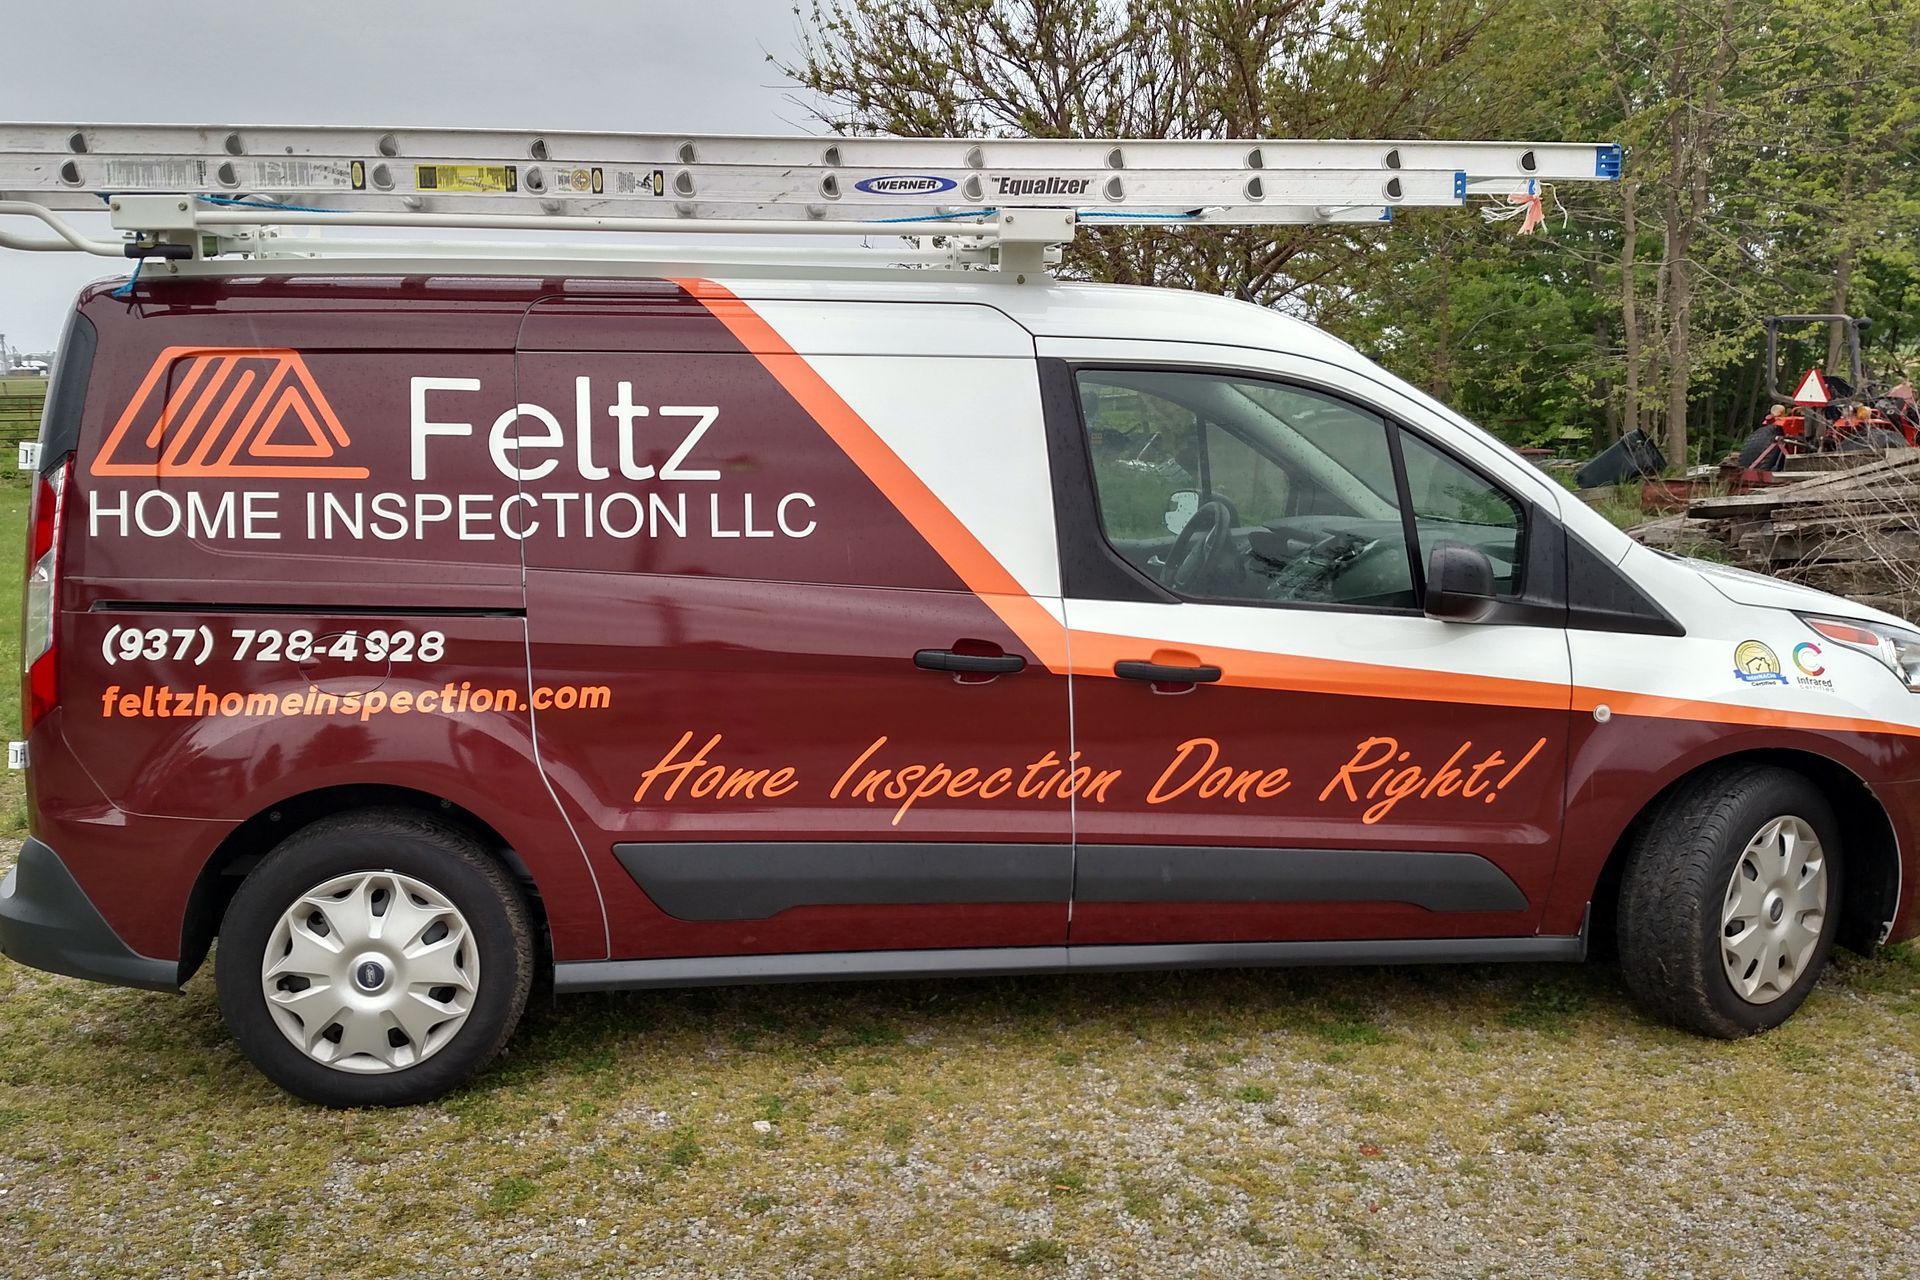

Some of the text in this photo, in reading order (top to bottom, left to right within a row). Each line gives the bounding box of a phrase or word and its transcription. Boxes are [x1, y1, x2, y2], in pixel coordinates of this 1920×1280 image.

[876, 180, 937, 190] WERNER
[998, 176, 1090, 196] Equalizer
[409, 375, 721, 482] Feltz
[88, 489, 818, 541] HOME INSPECTION LLC
[101, 624, 446, 666] (937) 728-4928
[101, 682, 612, 722] feltzhomeinspection.com
[1796, 676, 1833, 688] Infrared
[633, 731, 1548, 827] Home Inspection Done Right!
